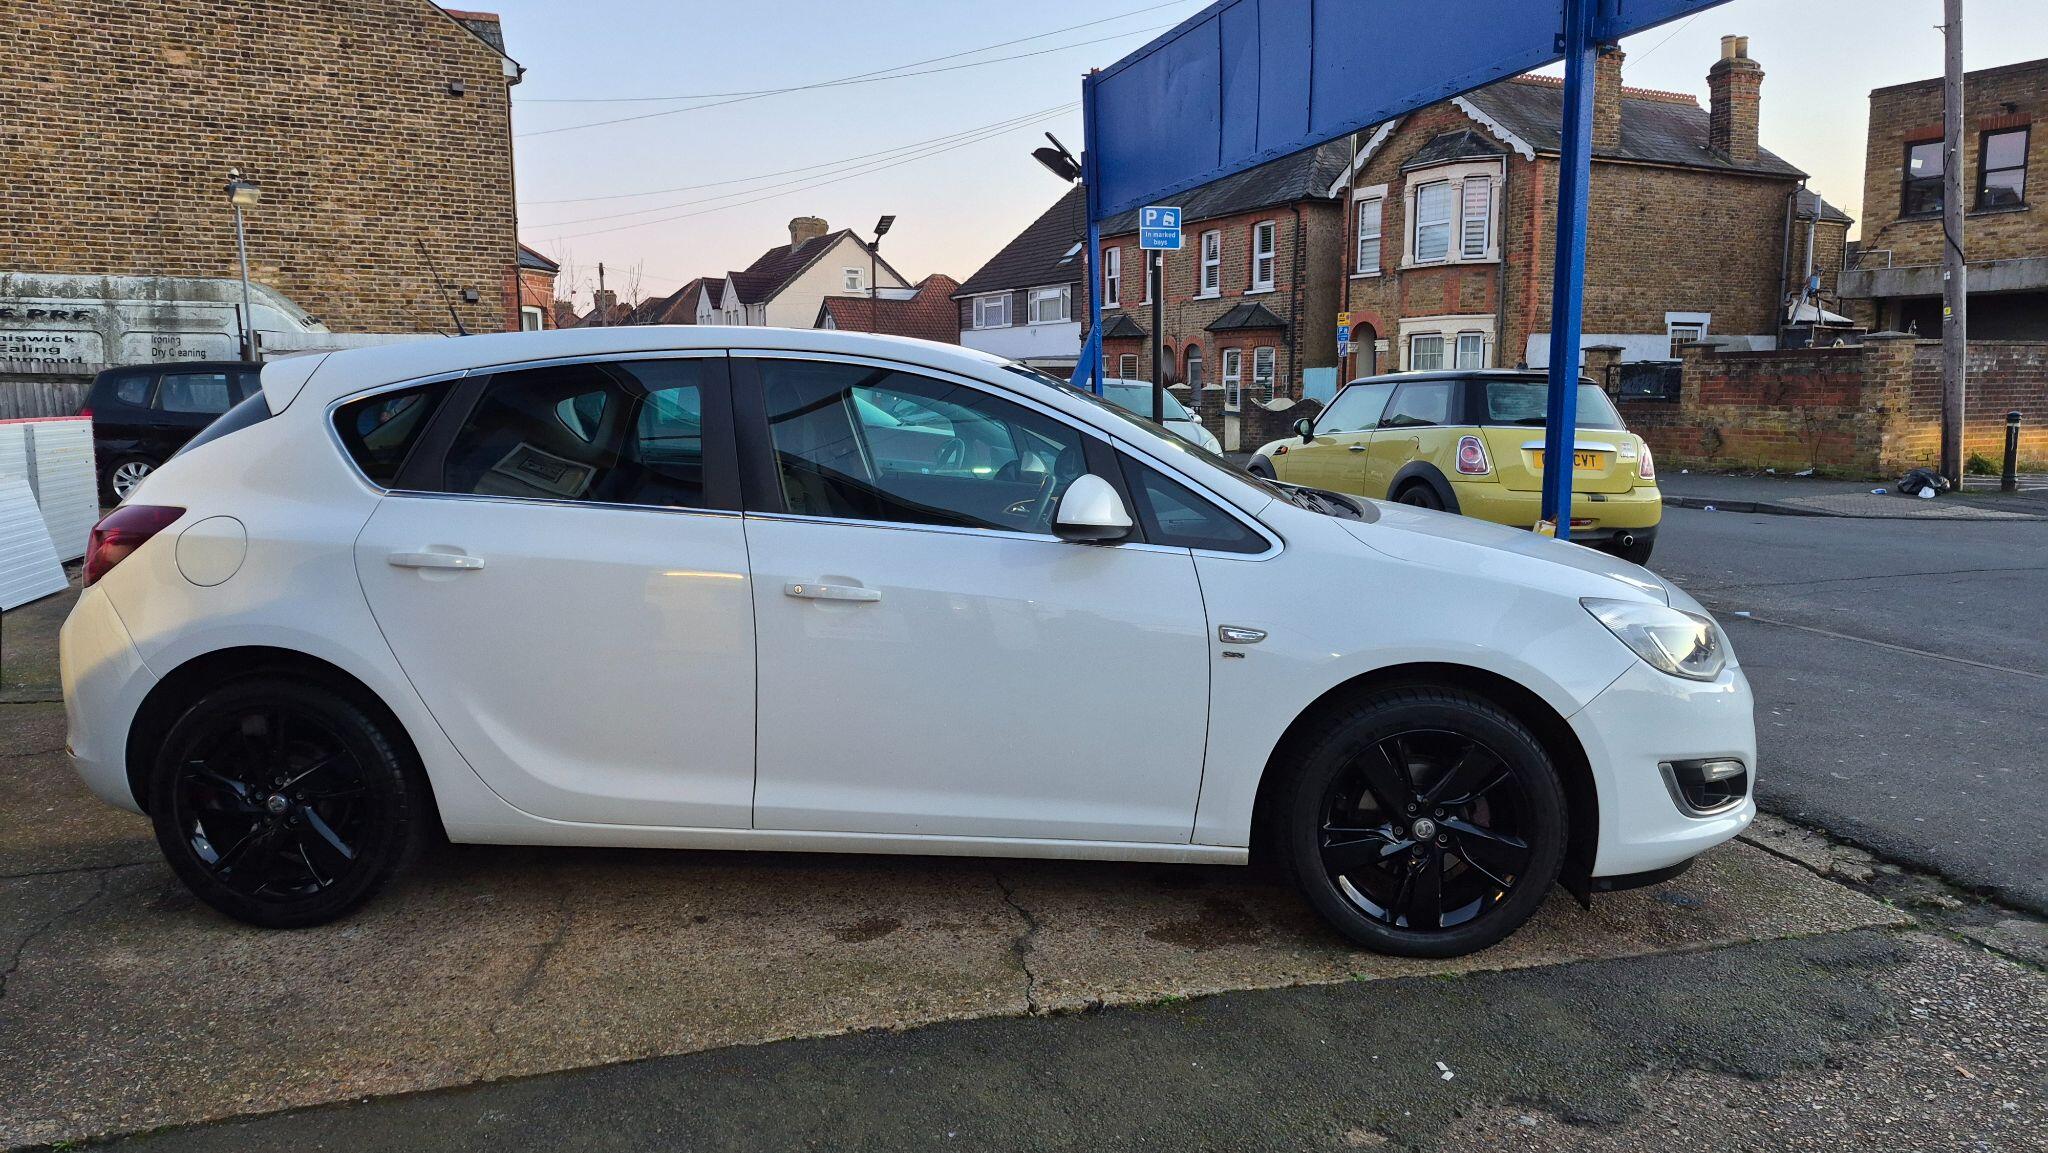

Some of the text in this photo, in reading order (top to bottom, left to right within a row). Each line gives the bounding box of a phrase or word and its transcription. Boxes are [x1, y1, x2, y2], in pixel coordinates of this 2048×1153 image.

[1146, 210, 1157, 226] P
[151, 347, 206, 359] Dry Ceaning
